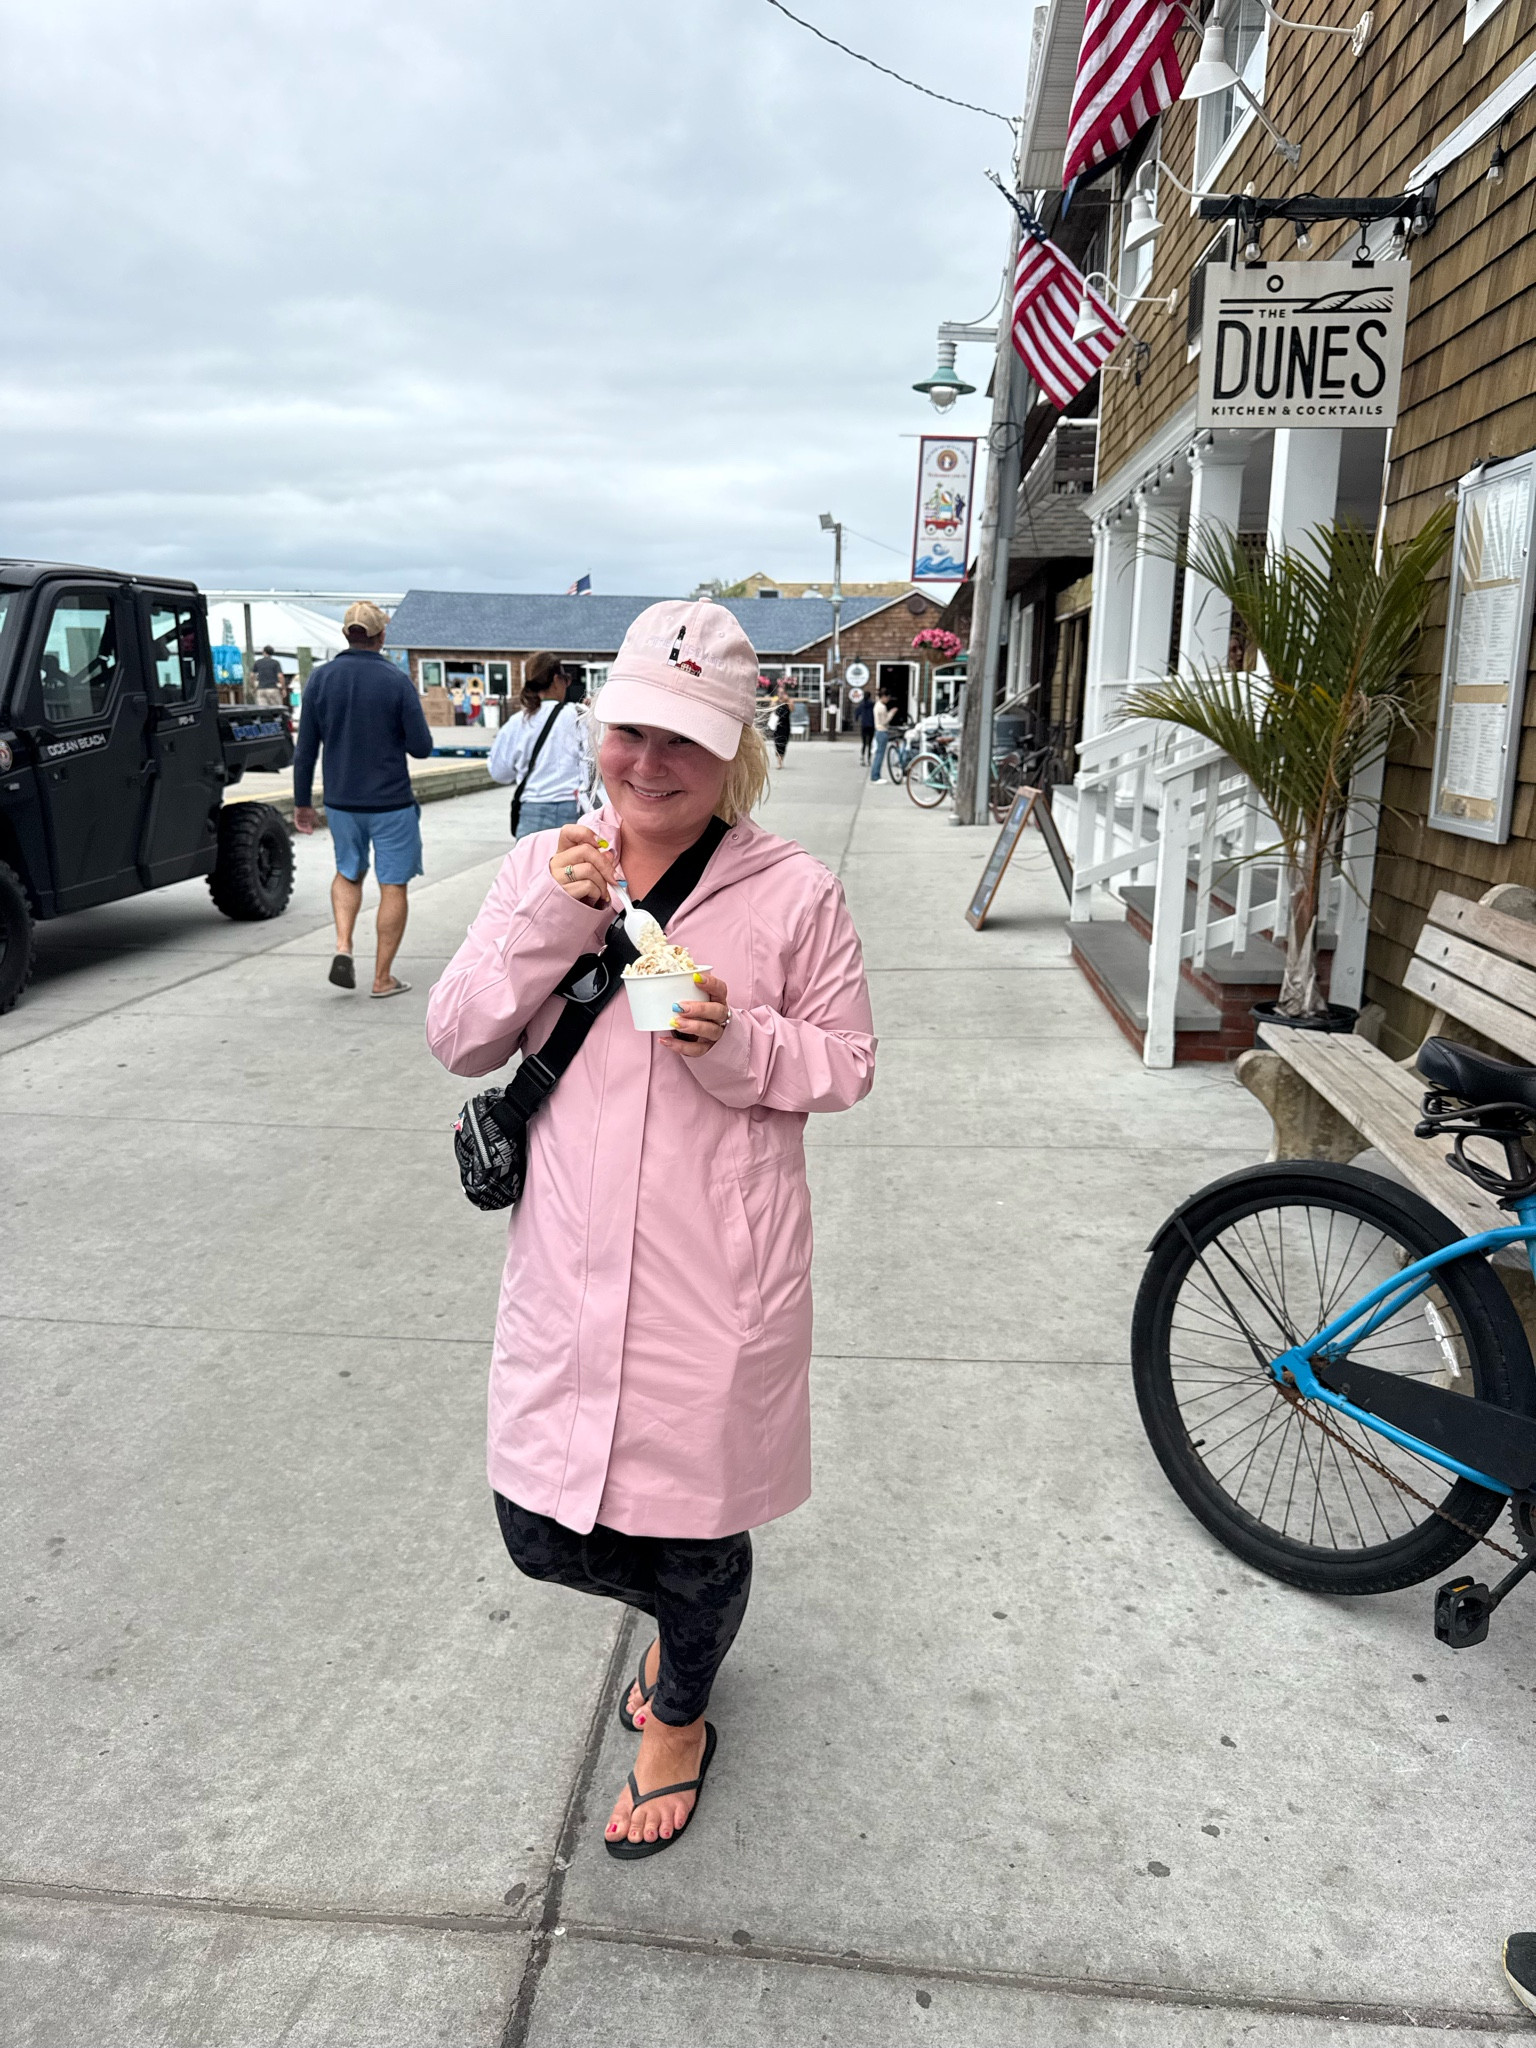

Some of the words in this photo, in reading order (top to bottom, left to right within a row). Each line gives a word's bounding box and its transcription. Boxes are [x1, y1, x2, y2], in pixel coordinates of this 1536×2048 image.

[1258, 309, 1286, 319] THE
[1213, 319, 1388, 399] DUNES
[1211, 406, 1277, 416] KITCHEN
[1281, 406, 1291, 416] &
[1296, 405, 1384, 416] COCKTAILS
[47, 740, 79, 756] OCEAN
[77, 732, 107, 749] BEACH
